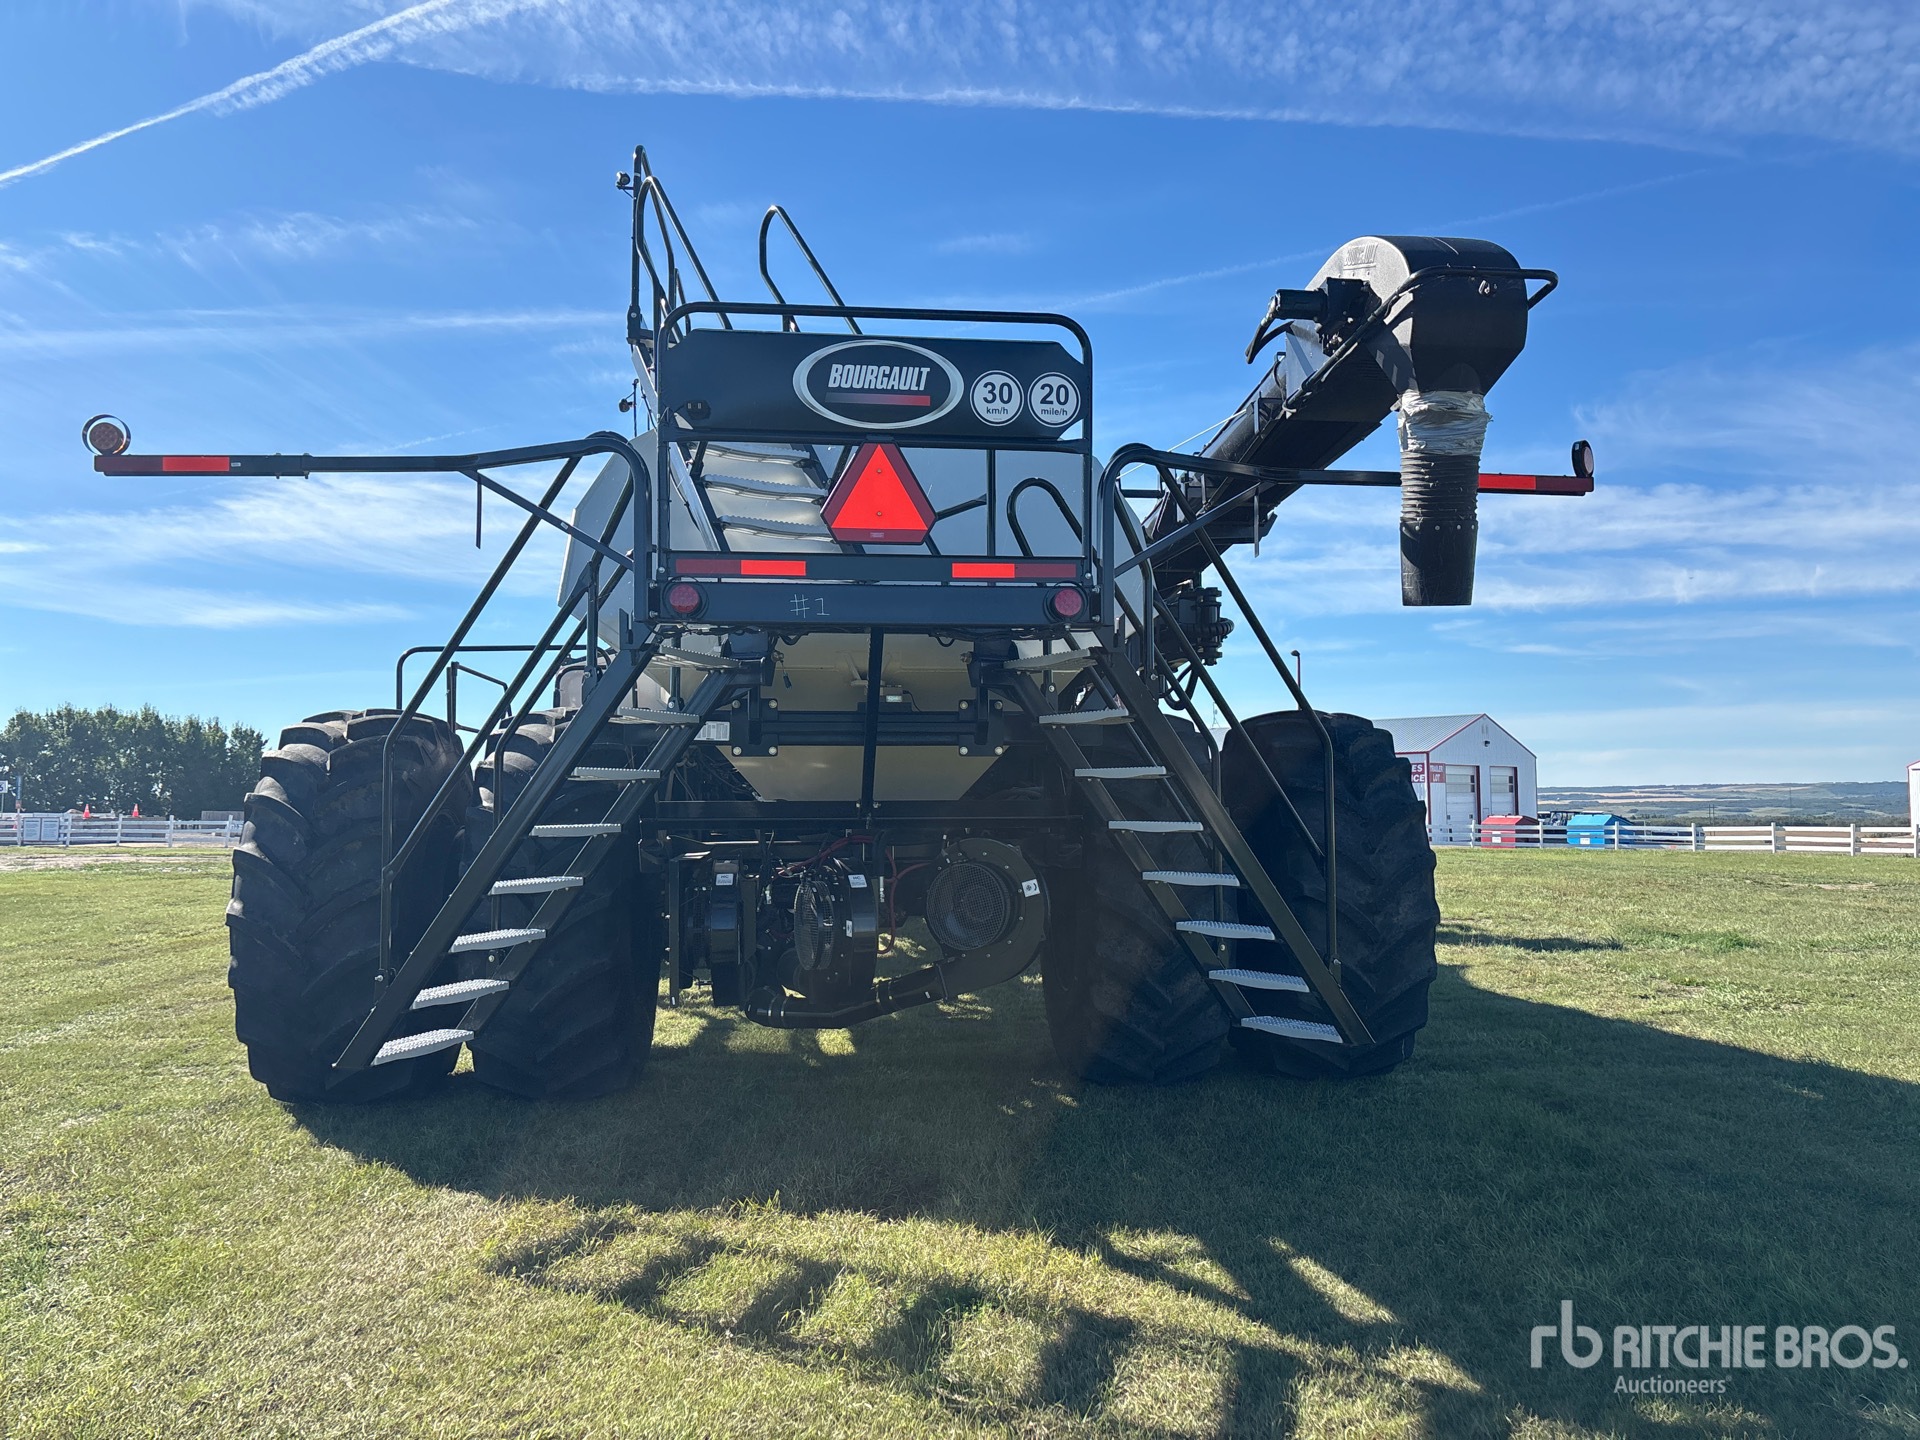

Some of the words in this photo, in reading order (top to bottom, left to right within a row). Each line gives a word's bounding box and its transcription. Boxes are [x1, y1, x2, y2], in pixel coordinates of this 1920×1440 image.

[828, 364, 931, 391] BOURGAULT
[982, 381, 1013, 405] 30
[1040, 383, 1070, 406] 20
[986, 406, 1009, 415] km/h
[1040, 407, 1068, 416] mile/h
[790, 594, 830, 618] #1
[1411, 764, 1422, 772] ES
